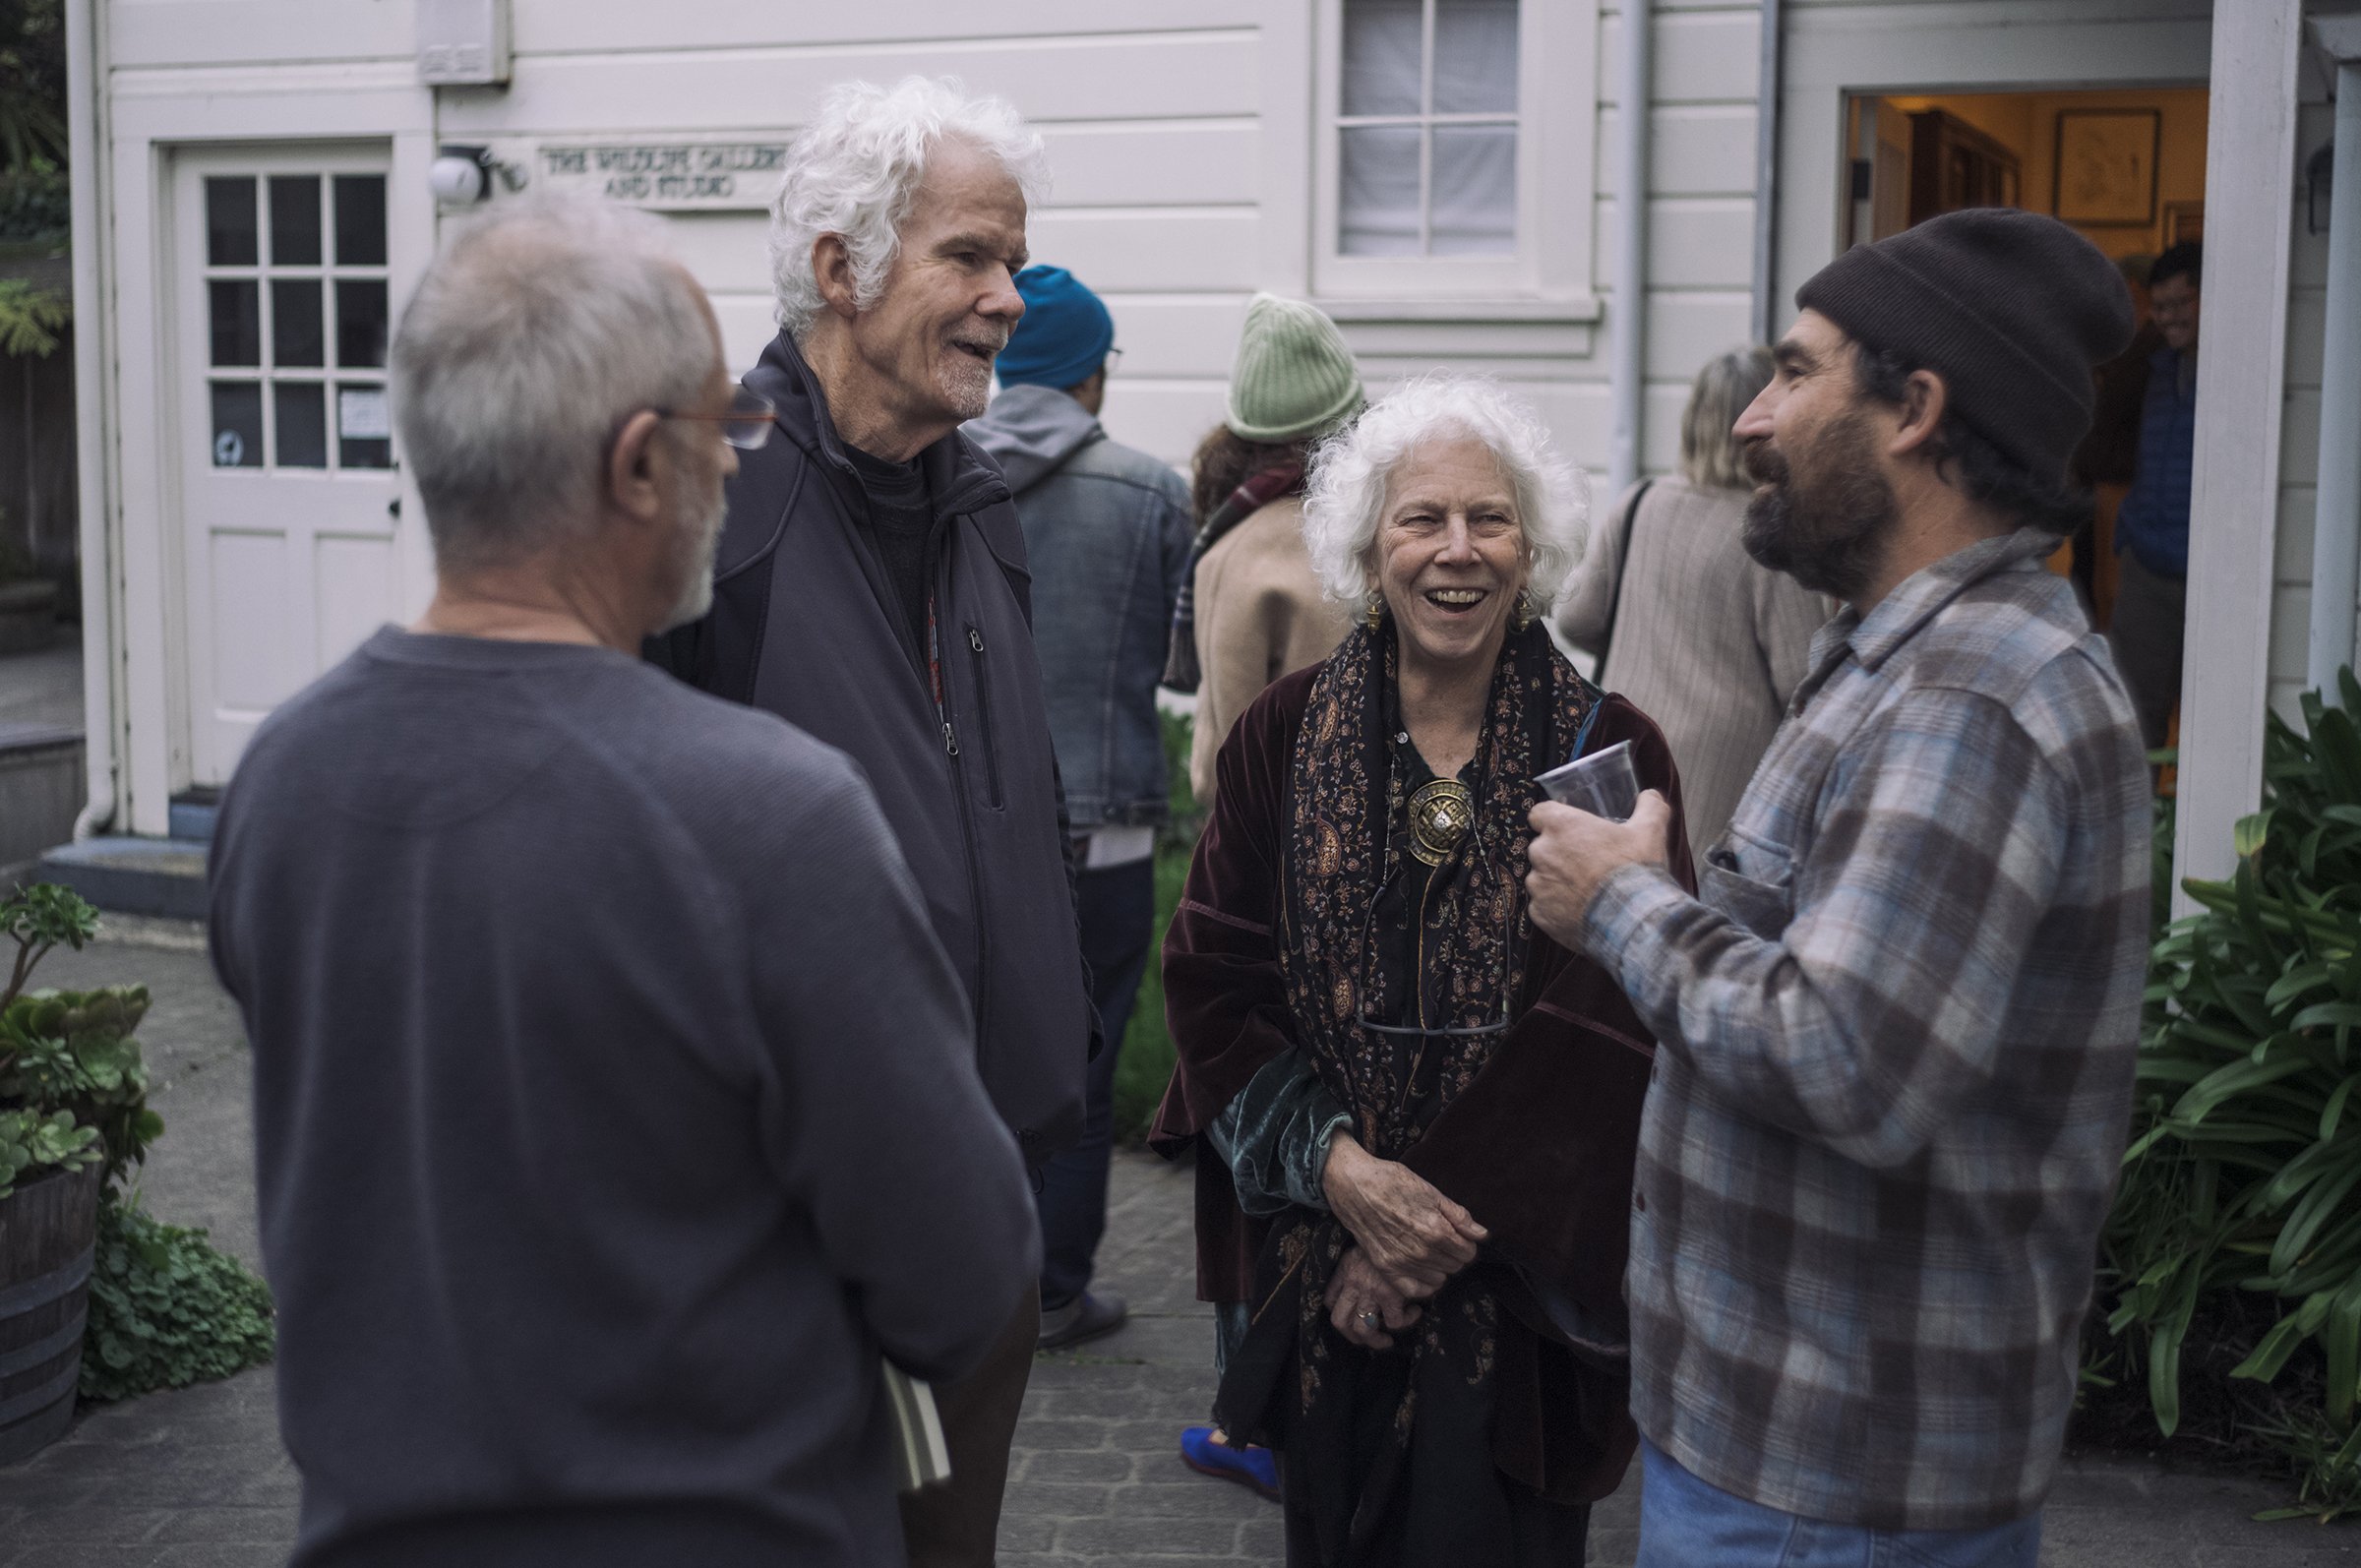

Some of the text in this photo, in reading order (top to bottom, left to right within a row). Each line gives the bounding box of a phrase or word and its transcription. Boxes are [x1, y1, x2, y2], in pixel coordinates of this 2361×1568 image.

[546, 150, 587, 174] THE
[603, 174, 734, 199] AND STUDIO
